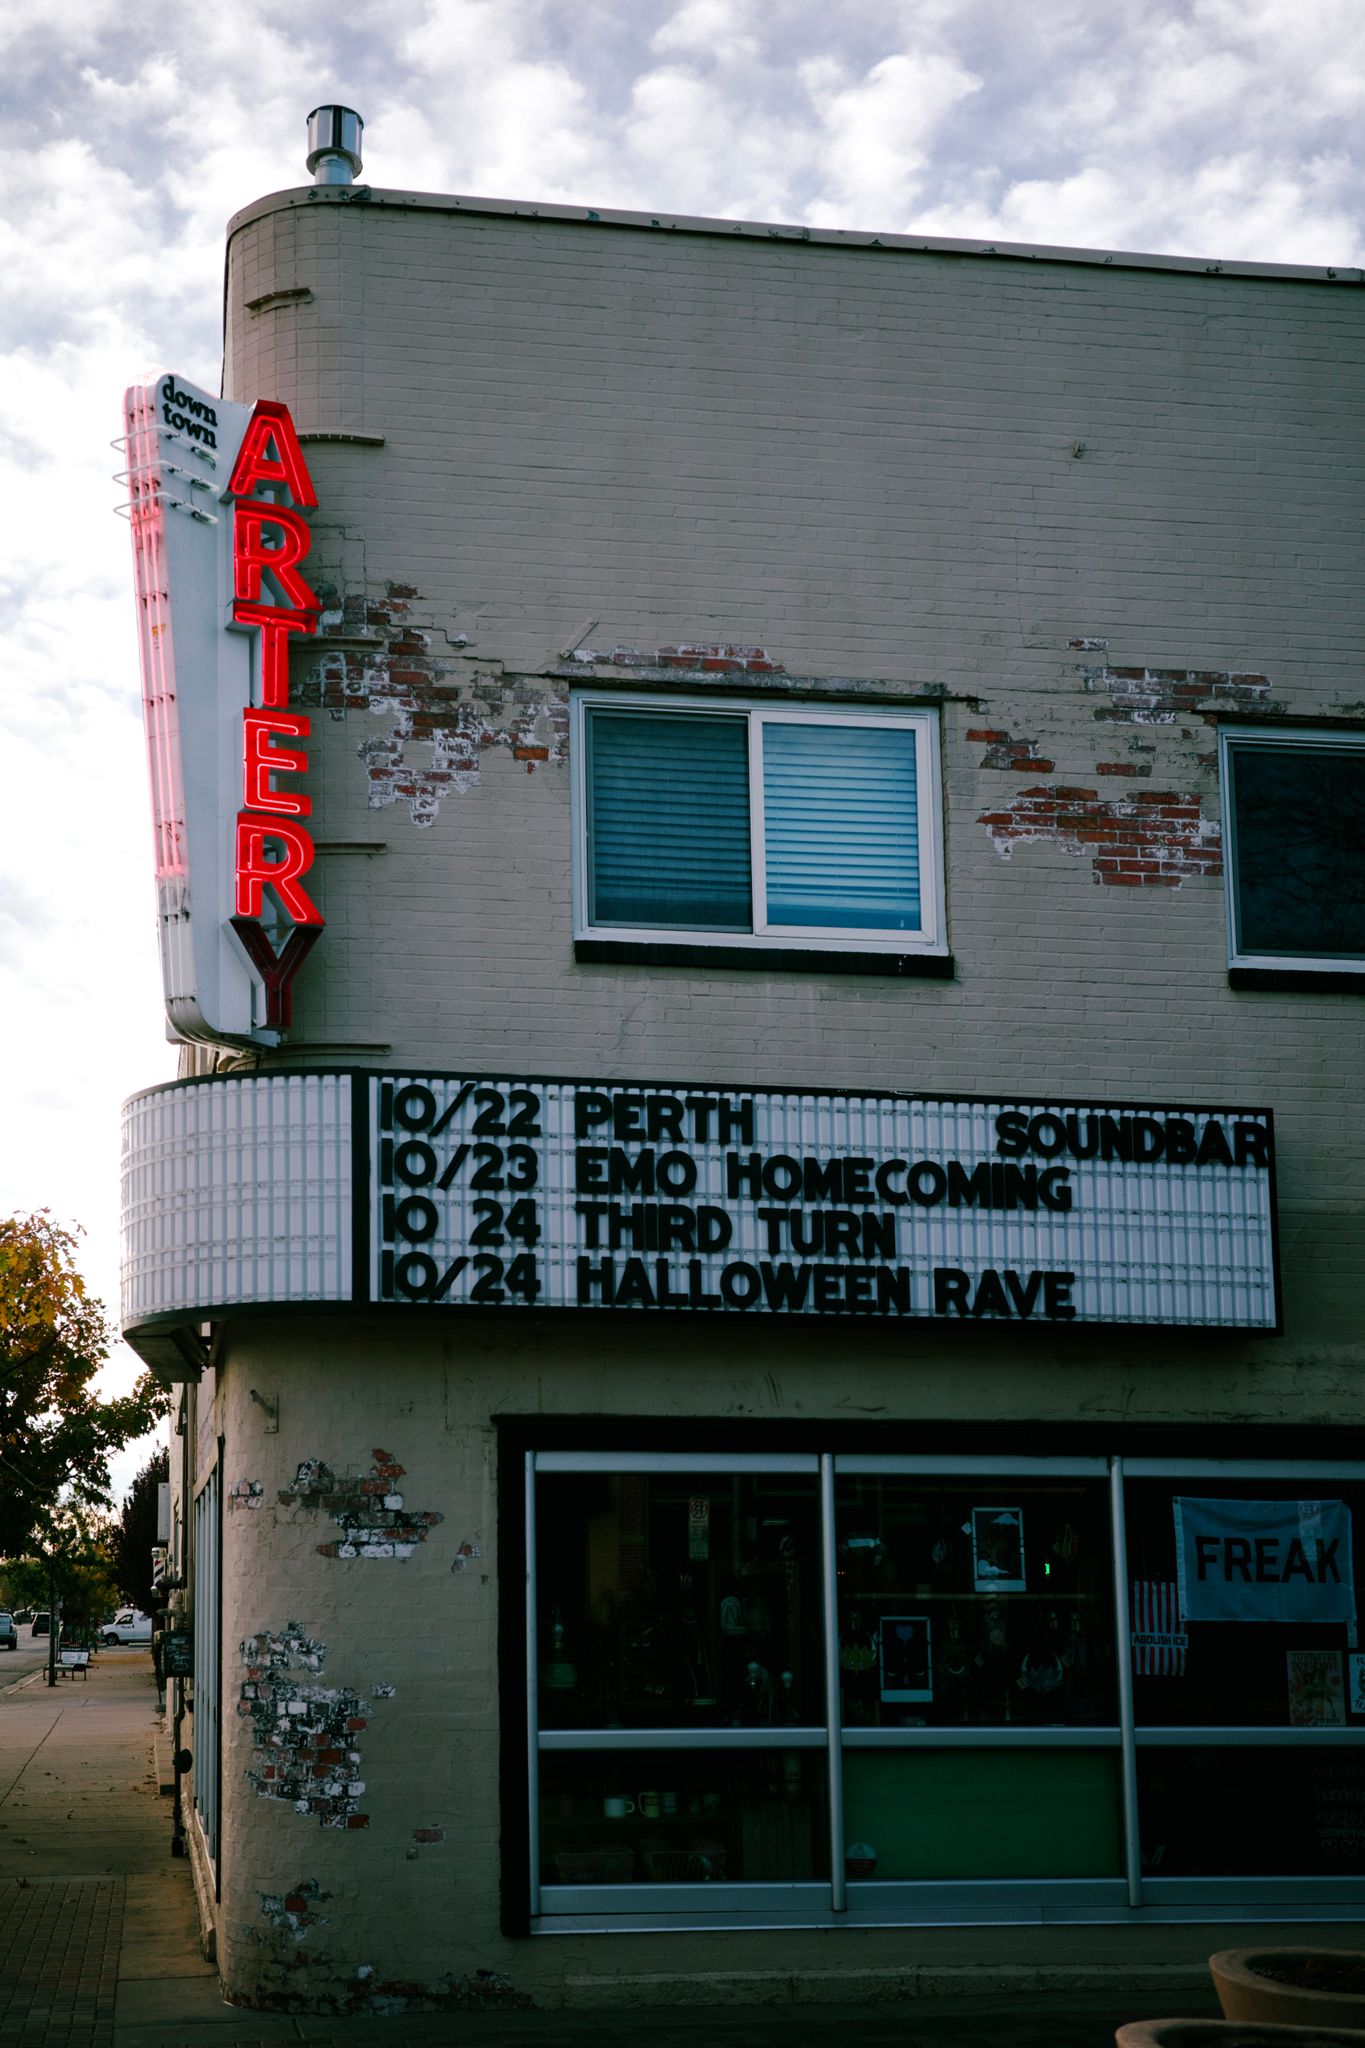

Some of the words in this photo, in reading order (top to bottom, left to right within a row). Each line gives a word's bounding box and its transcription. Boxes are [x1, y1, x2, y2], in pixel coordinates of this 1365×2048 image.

[162, 376, 218, 427] down
[162, 403, 217, 449] town
[226, 399, 326, 1029] ARTERY
[381, 1083, 541, 1137] 10/22
[575, 1091, 753, 1145] PERTH
[996, 1111, 1267, 1167] SOUNDBAR
[381, 1138, 539, 1191] 10/23
[576, 1146, 697, 1197] EMO
[727, 1152, 1072, 1211] HOMECOMING
[469, 1198, 541, 1247] 24
[575, 1201, 732, 1253] THIRD
[758, 1208, 895, 1259] TURN
[381, 1250, 541, 1301] 10/24
[577, 1256, 910, 1313] HALLOWEEN
[934, 1267, 1076, 1318] RAVE
[1195, 1536, 1342, 1584] FREAK
[1134, 1635, 1171, 1645] ABOLISH
[1173, 1636, 1187, 1646] ICE
